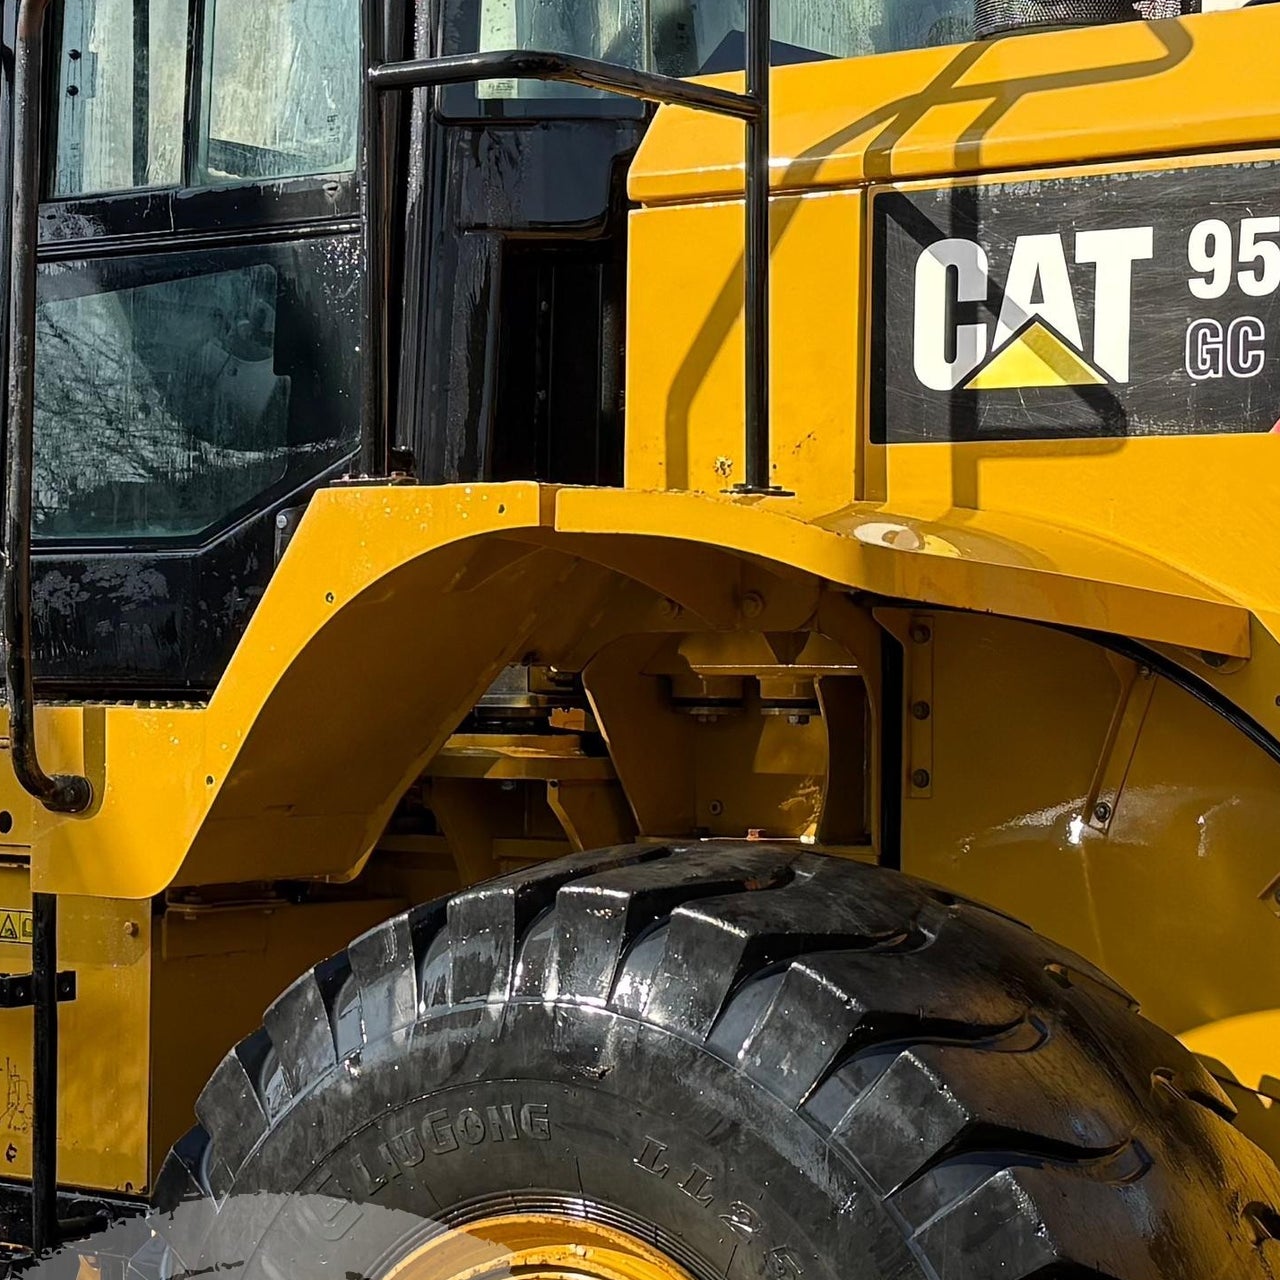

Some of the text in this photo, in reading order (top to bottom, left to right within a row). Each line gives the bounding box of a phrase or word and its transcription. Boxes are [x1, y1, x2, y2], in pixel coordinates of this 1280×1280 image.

[913, 226, 1154, 391] CAT
[1185, 316, 1266, 380] GC
[349, 1102, 553, 1197] LIUGONG
